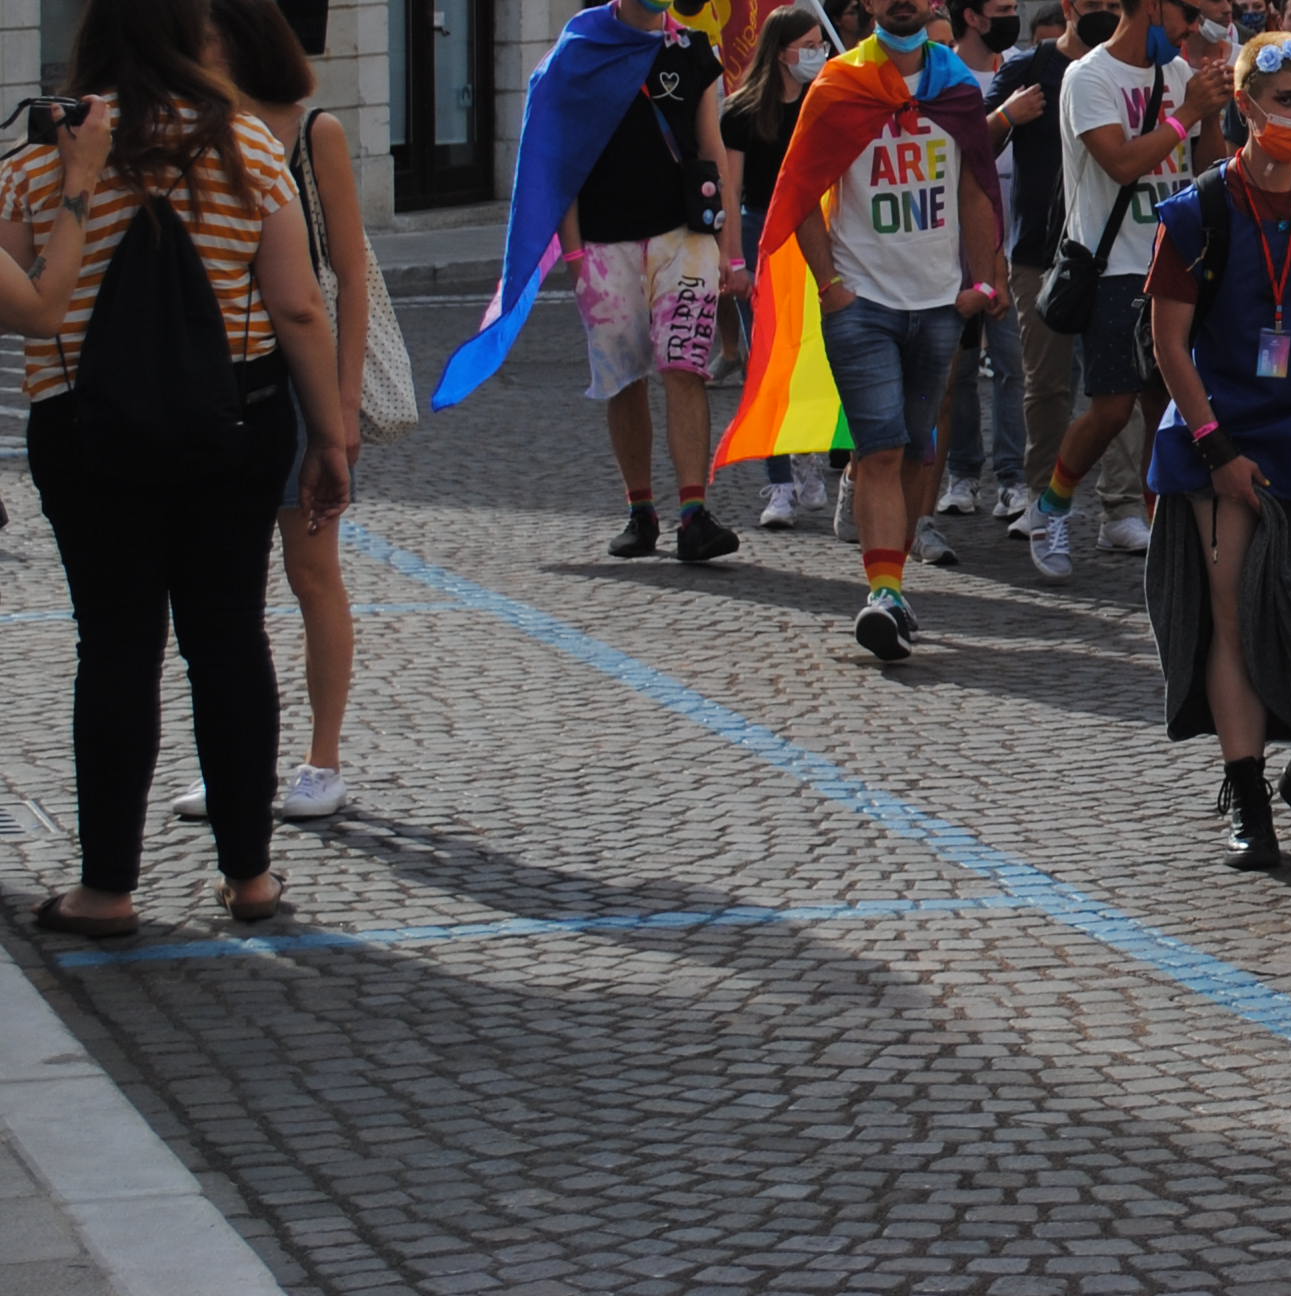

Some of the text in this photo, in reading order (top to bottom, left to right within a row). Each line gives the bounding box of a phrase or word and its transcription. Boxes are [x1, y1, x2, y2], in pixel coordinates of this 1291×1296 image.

[870, 139, 947, 187] ARE
[872, 186, 945, 234] ONE
[667, 275, 705, 363] TRIPPY
